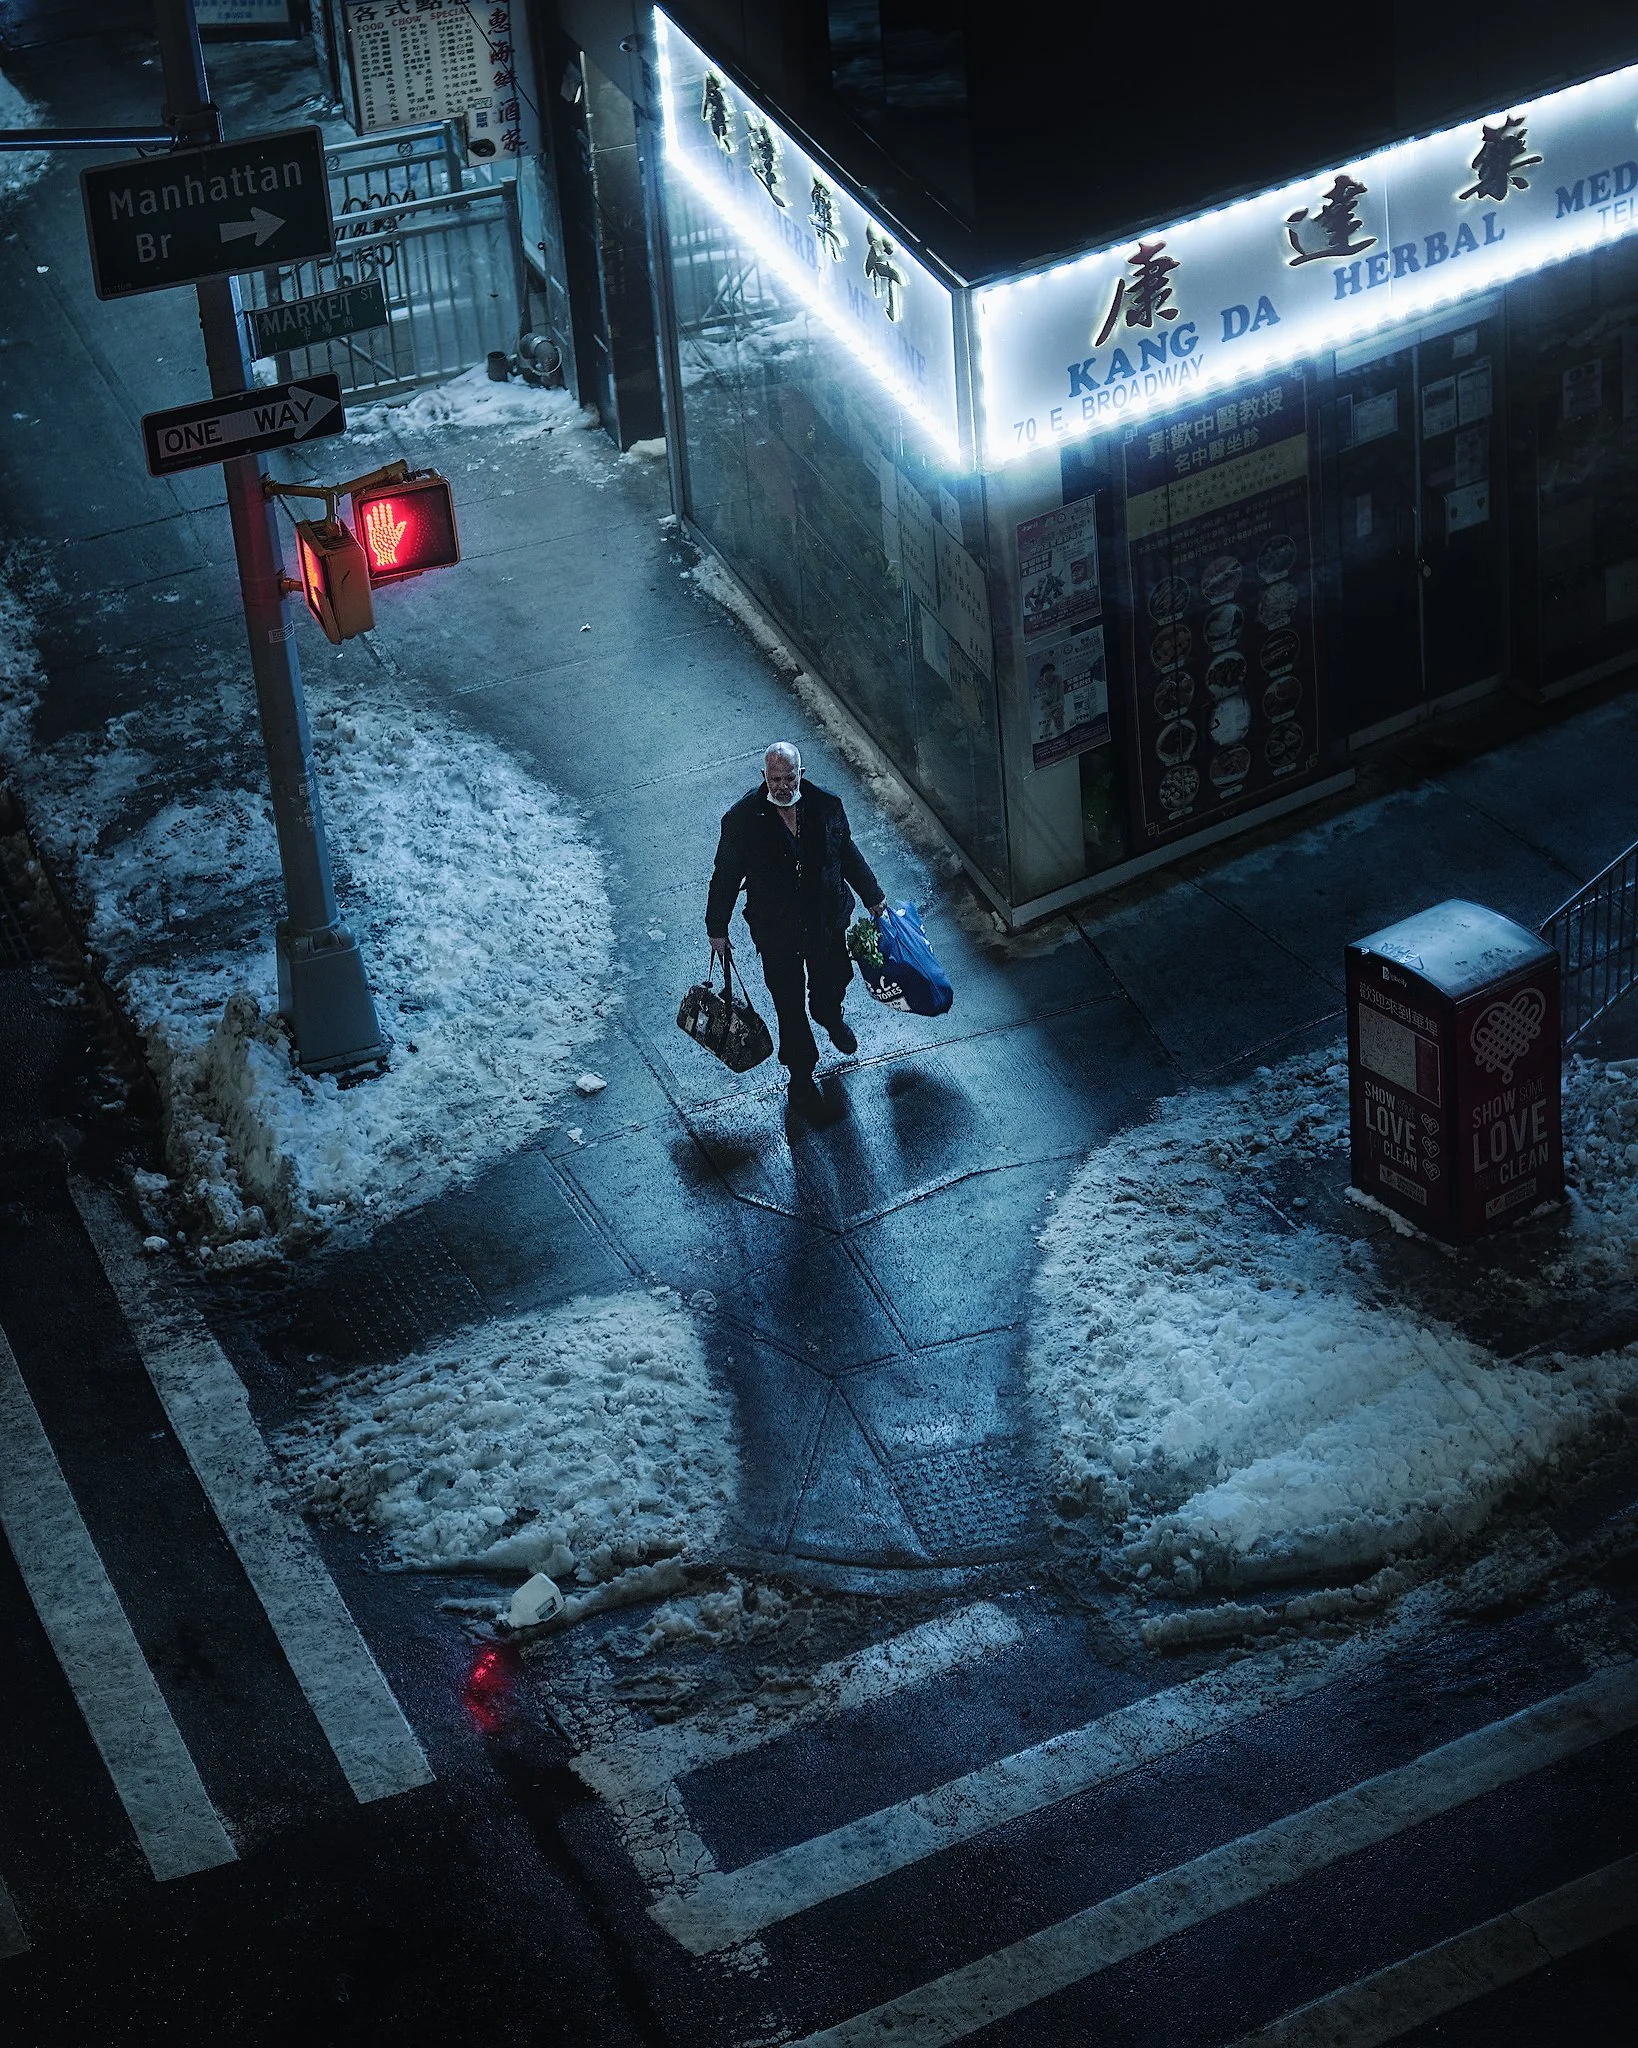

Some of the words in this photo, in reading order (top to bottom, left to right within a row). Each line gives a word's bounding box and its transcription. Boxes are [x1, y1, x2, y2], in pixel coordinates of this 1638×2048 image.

[485, 0, 528, 151] 惠海鮮酒家
[109, 159, 303, 221] Manhattan
[135, 232, 172, 264] Br
[1067, 321, 1200, 398] KANG
[1221, 295, 1281, 342] DA
[1334, 211, 1506, 300] HERBAL
[1555, 160, 1638, 219] MED
[261, 294, 352, 338] MARKET
[360, 286, 375, 300] ST
[164, 420, 222, 452] ONE
[254, 397, 315, 432] WAY
[1013, 417, 1037, 443] 70
[1082, 353, 1205, 421] BROADWAY
[1364, 1080, 1396, 1111] SHOW
[1472, 1087, 1517, 1130] SHOW
[1519, 1076, 1545, 1100] SOME
[1364, 1099, 1417, 1153] LOVE
[1472, 1098, 1549, 1173] LOVE
[1383, 1138, 1418, 1173] CLEAN
[1499, 1144, 1550, 1185] CLEAN
